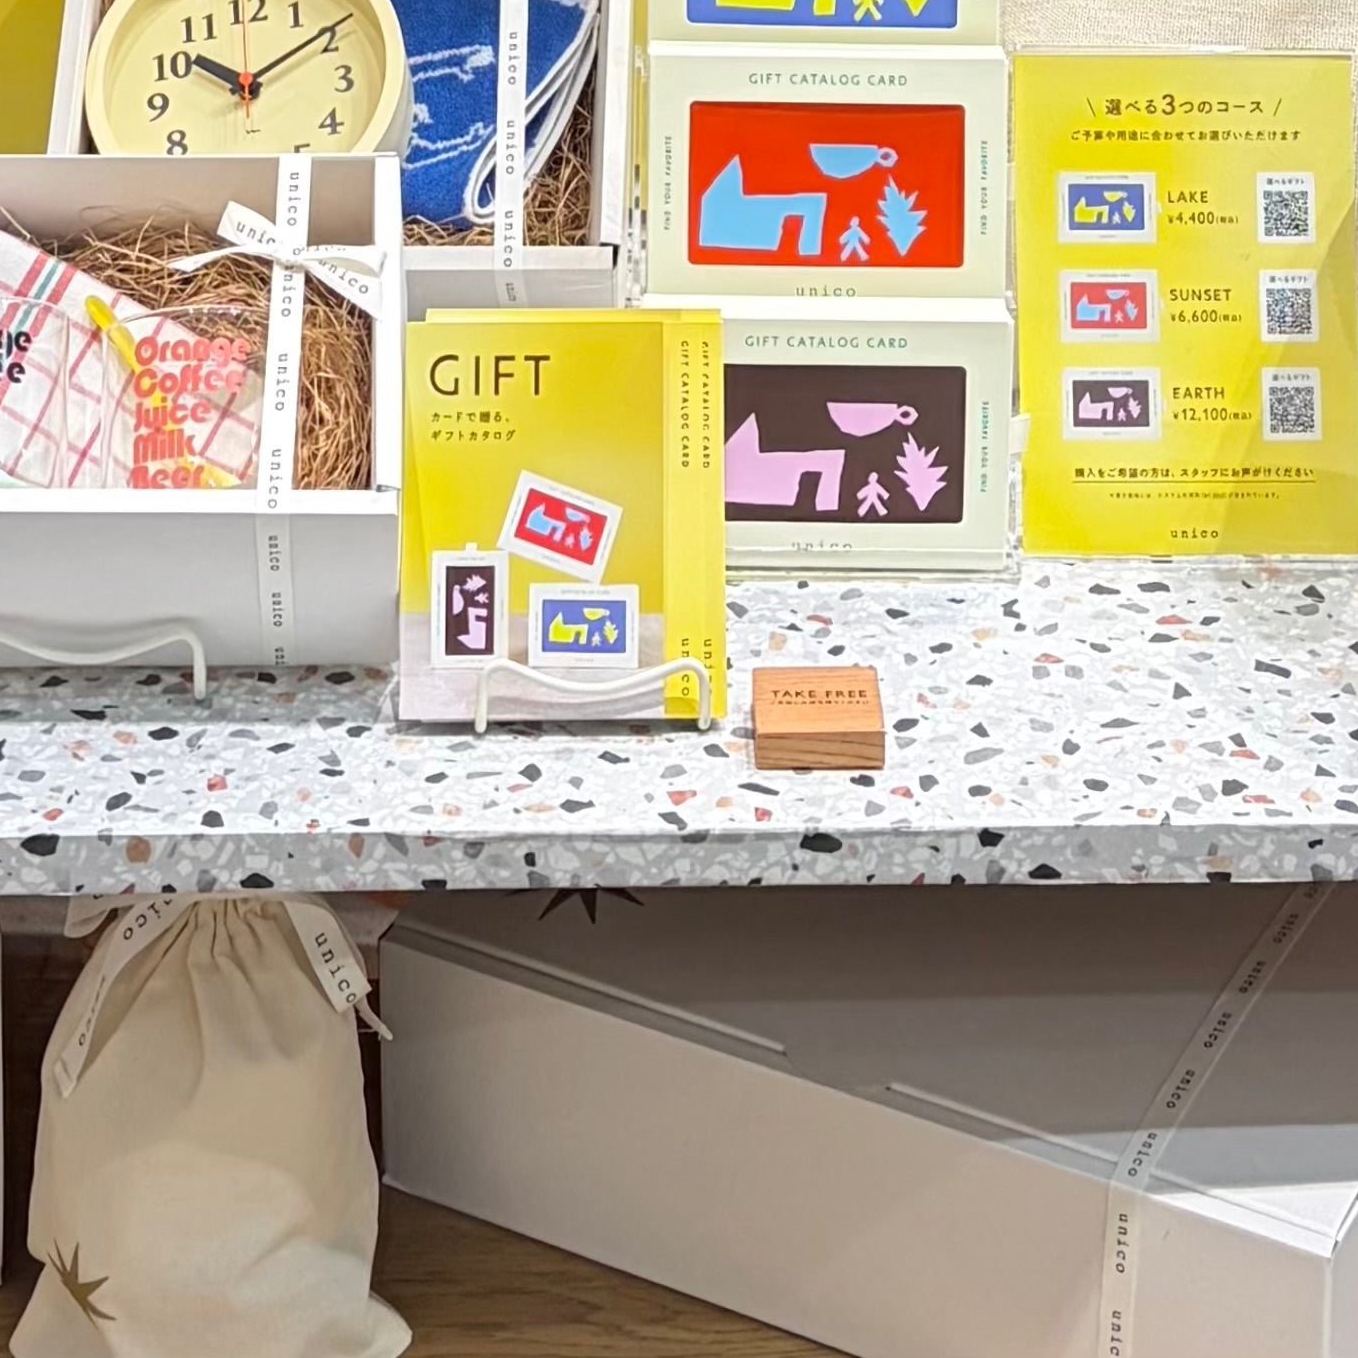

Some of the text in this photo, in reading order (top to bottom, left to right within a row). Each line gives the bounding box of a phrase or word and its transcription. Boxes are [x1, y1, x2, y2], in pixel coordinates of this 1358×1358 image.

[180, 13, 217, 44] 11
[288, 1, 304, 29] 1
[318, 25, 339, 54] 2
[152, 50, 193, 82] 10
[508, 31, 521, 87] unico
[334, 64, 354, 93] 3
[748, 72, 908, 87] GIFT CATALOG CARD
[147, 93, 170, 122] 9
[1104, 93, 1264, 116] 選べる3つのコース
[318, 107, 344, 135] 4
[1070, 129, 1302, 143] ご予算や用途に合わせてお選びいただけます
[165, 129, 188, 155] 8
[505, 120, 518, 175] unico
[287, 171, 302, 227] unico
[1167, 190, 1209, 204] LAKE
[236, 220, 277, 245] unic
[503, 210, 517, 268] unico
[796, 285, 858, 298] unico
[1169, 288, 1233, 302] SUNSET
[134, 336, 252, 368] Orange
[745, 335, 908, 349] GIFT CATALOG CARD
[133, 363, 244, 404] Coffee
[274, 352, 290, 412] unico
[429, 354, 551, 397] GIFT
[680, 340, 690, 468] GIFT CATALOG CARD
[1172, 386, 1226, 400] EARTH
[133, 396, 212, 433] Juice
[133, 426, 197, 465] Milk
[430, 428, 517, 443] ギフトカタログ
[130, 464, 205, 489] Beer
[267, 448, 282, 510] unico
[1170, 527, 1220, 540] unico
[267, 534, 280, 572] unico
[271, 591, 283, 628] unico
[681, 637, 690, 697] unco
[771, 689, 868, 699] TAKE FREE
[314, 931, 358, 1005] unico
[1166, 1069, 1196, 1109] unico
[1127, 1131, 1158, 1177] unico
[1115, 1212, 1130, 1274] unico
[1109, 1309, 1123, 1357] unic
